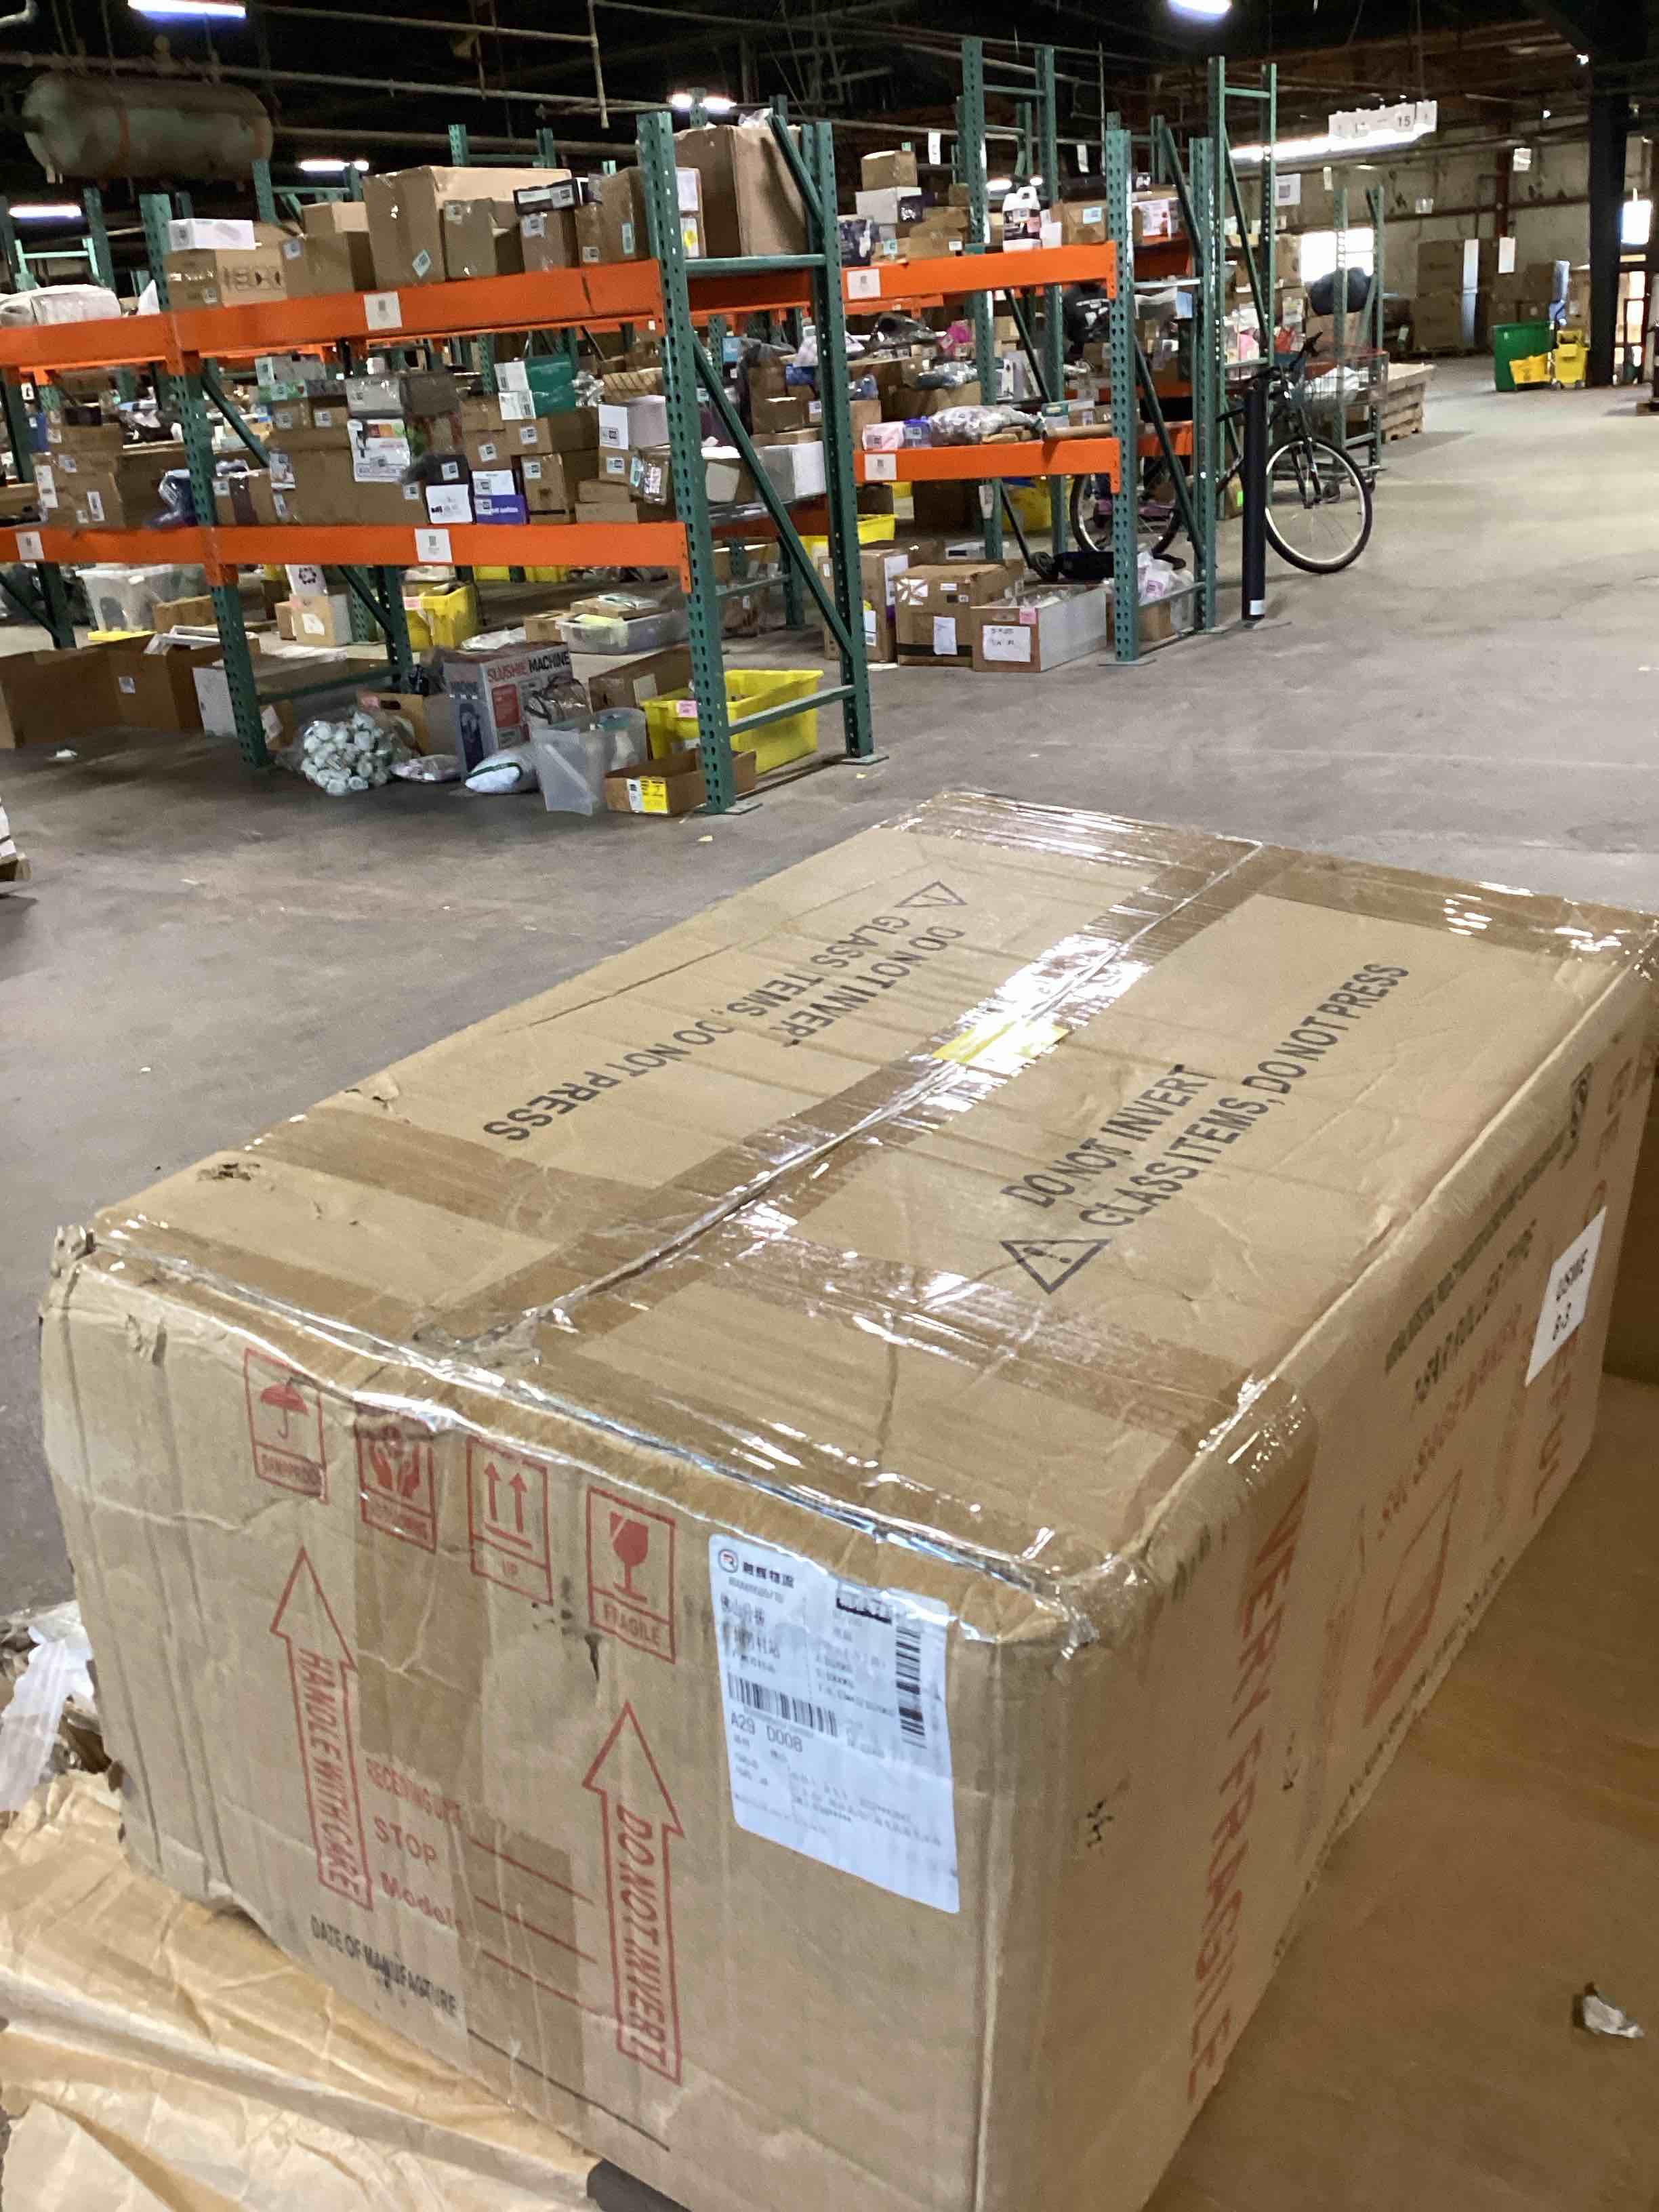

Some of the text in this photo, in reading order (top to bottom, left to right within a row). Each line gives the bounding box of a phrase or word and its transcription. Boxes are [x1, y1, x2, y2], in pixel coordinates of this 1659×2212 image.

[529, 651, 571, 673] MACHINE
[811, 915, 909, 968] GLASS
[909, 925, 966, 951] DO
[856, 950, 929, 989] NOT
[1316, 963, 1410, 1019] PRESS
[673, 1019, 735, 1046] DO
[1273, 1015, 1349, 1062] NOT
[605, 1043, 692, 1078] NOT
[1241, 1061, 1307, 1094] DO
[483, 1071, 621, 1141] PRESS
[1000, 1064, 1216, 1208] DO NOT INVERT
[1078, 1162, 1199, 1227] GLASS
[602, 1602, 662, 1647] FRAGILE
[298, 1647, 361, 1896] HANDLE WITH CARE
[374, 1814, 437, 1866] STOP
[311, 1913, 344, 1953] DATE
[344, 1934, 362, 1960] OF
[616, 1803, 667, 2068] DO NOT INVERT
